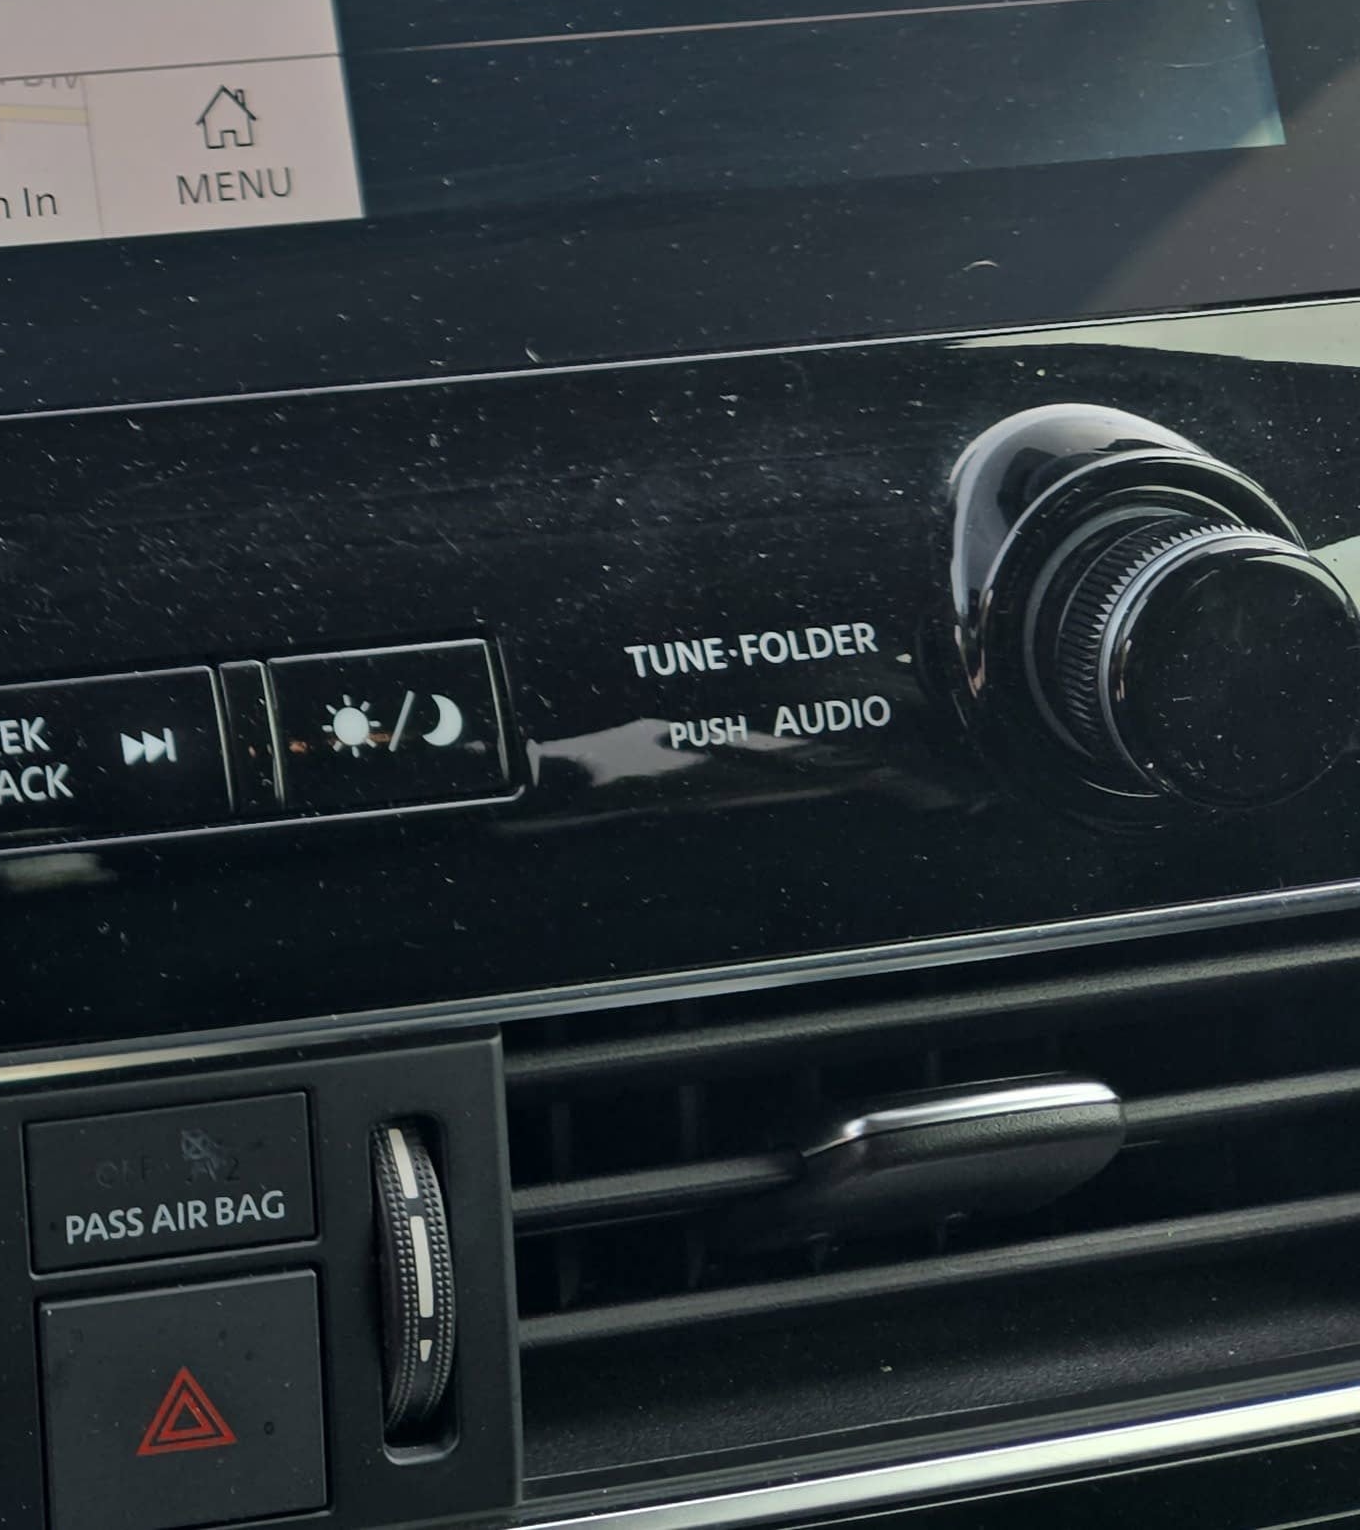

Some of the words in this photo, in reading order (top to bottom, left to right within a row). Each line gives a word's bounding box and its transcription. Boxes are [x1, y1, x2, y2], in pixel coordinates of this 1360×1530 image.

[22, 186, 58, 220] In
[176, 167, 294, 207] MENU
[668, 714, 749, 750] PUSH
[772, 695, 891, 738] AUDIO
[65, 1208, 144, 1245] PASS
[150, 1198, 209, 1233] AIR
[215, 1189, 286, 1226] BAG
